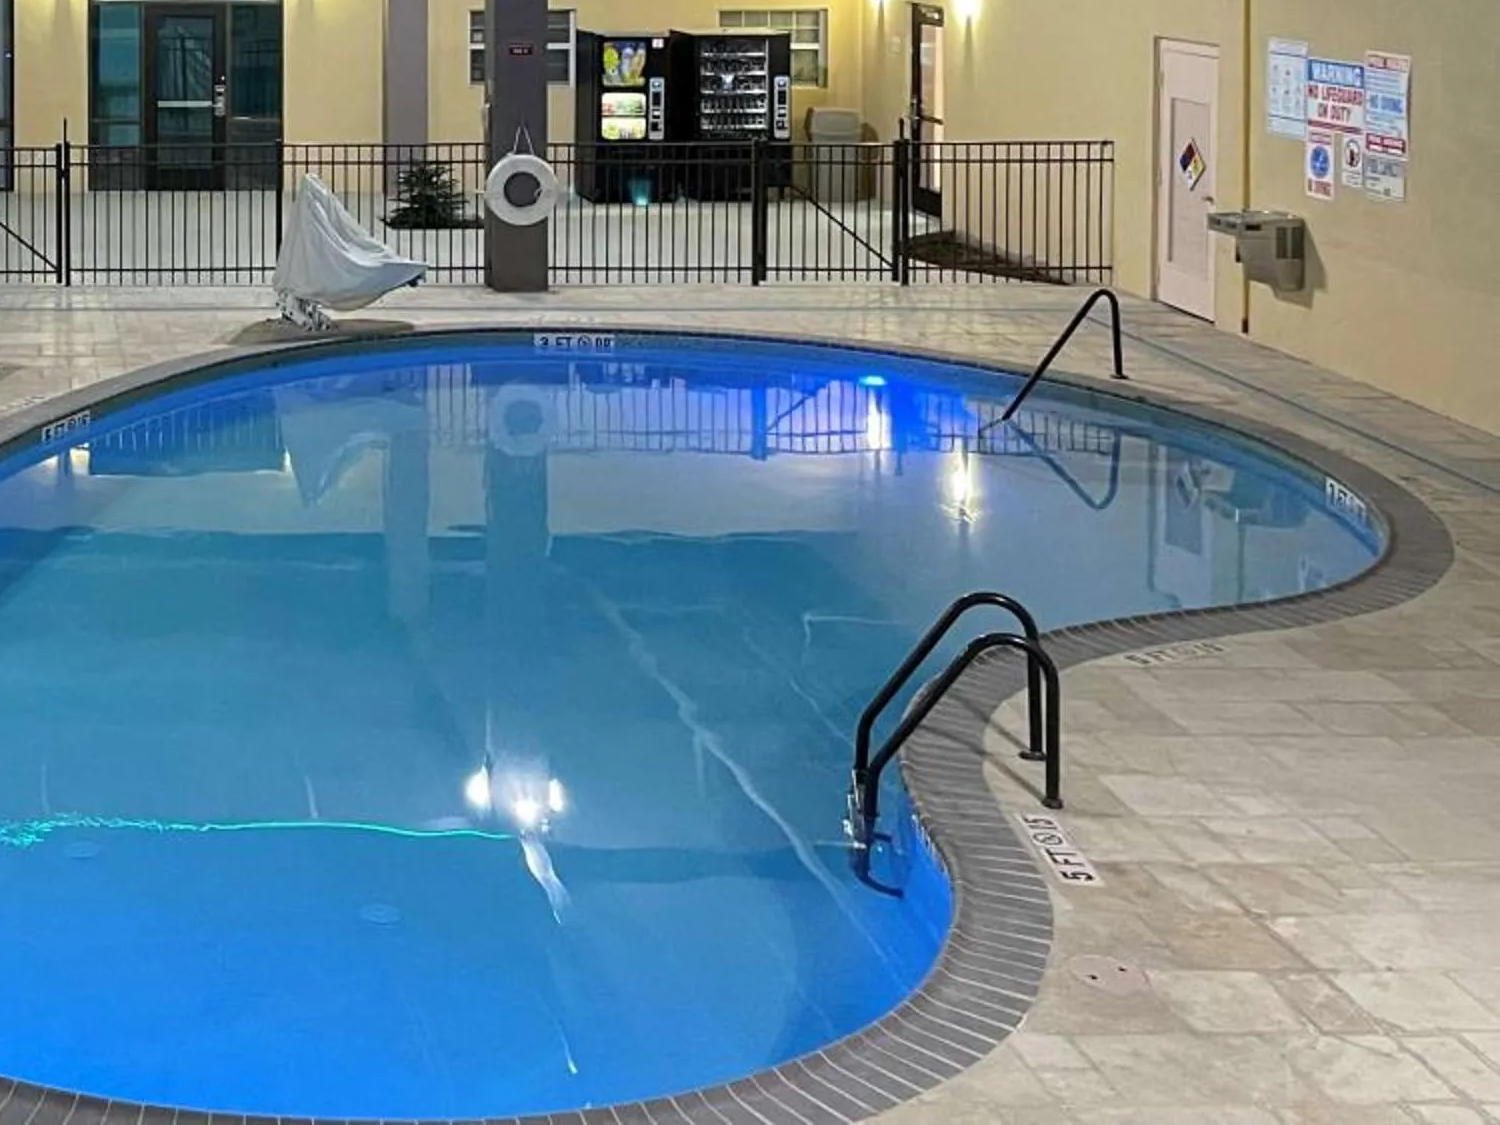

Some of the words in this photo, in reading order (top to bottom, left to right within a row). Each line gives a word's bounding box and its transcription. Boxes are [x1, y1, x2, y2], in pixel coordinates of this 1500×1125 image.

[1312, 62, 1361, 87] WARNING
[1308, 84, 1319, 100] NO
[1322, 86, 1363, 106] LIFEGUARD
[1317, 103, 1328, 118] ON
[1330, 105, 1352, 123] DUTY
[556, 336, 573, 348] FT
[1045, 847, 1086, 868] FT
[1060, 870, 1095, 881] 5
